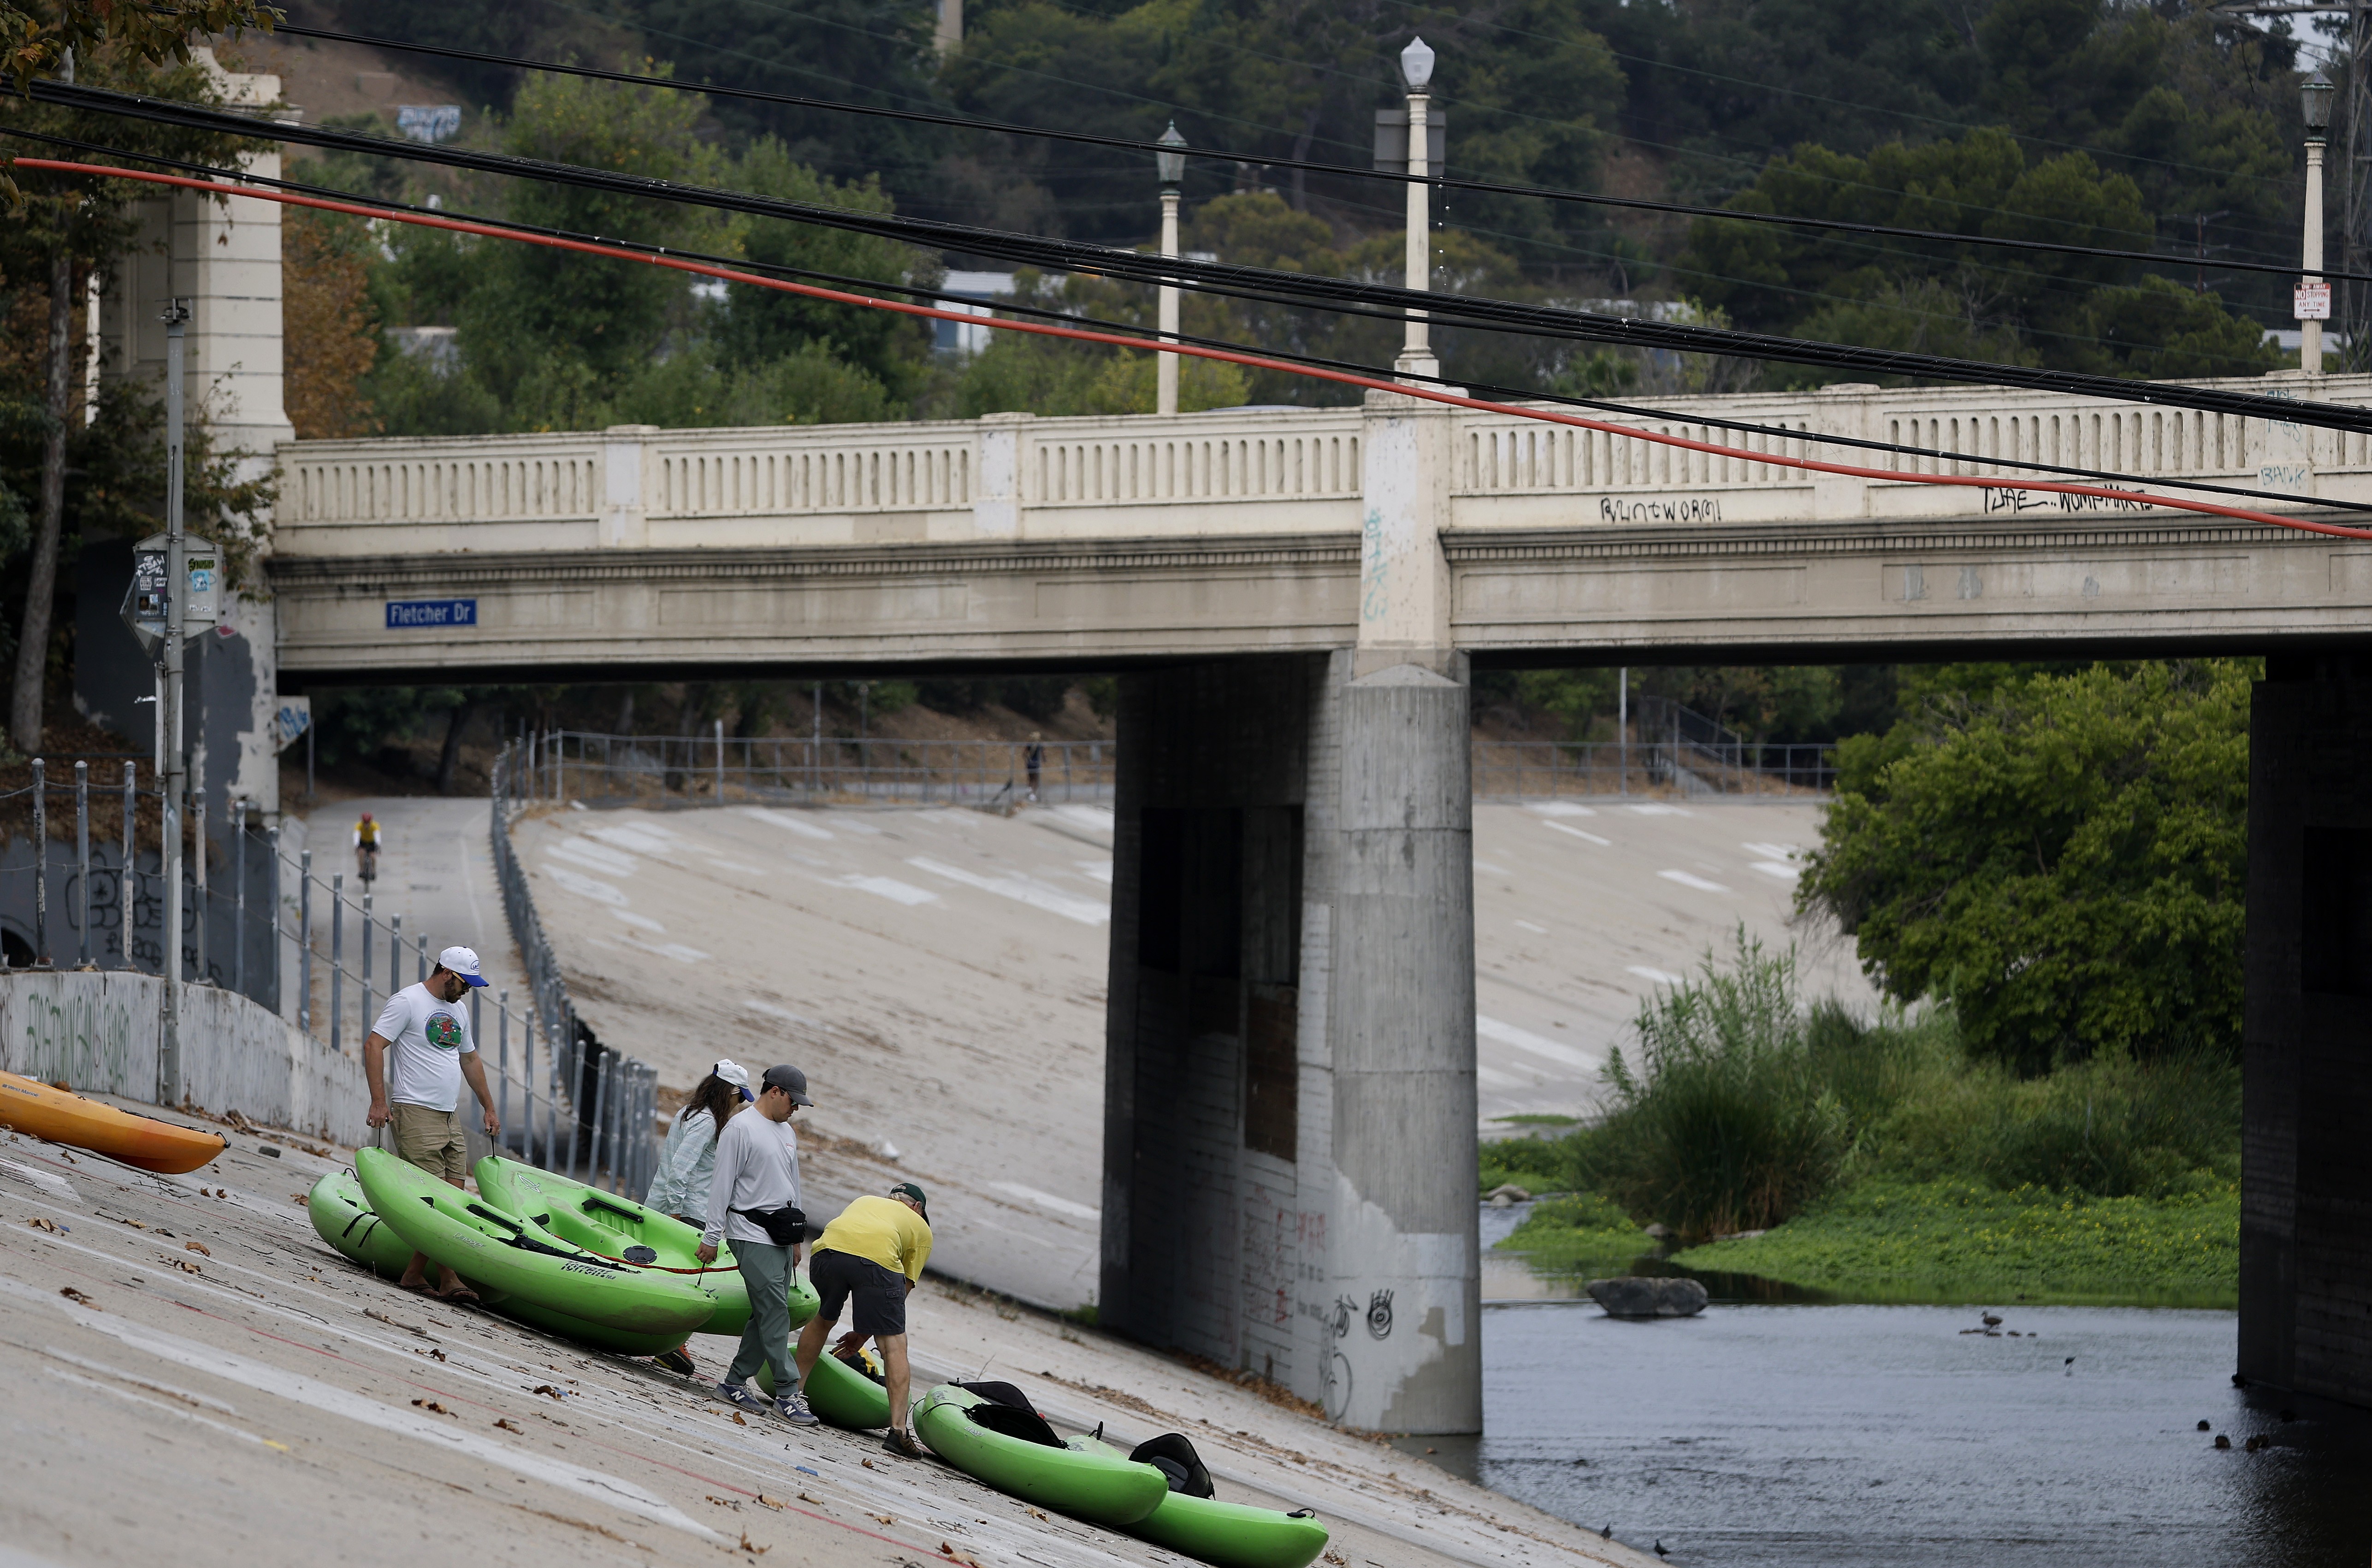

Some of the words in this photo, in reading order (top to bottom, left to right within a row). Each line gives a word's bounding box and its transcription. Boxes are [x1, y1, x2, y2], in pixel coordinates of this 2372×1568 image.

[2295, 290, 2306, 299] NO
[390, 603, 449, 624] Fletcher
[453, 602, 471, 622] Dr
[21, 1089, 39, 1097] Marine
[453, 1232, 486, 1248] Dagger
[561, 1260, 614, 1278] Torrent
[731, 1390, 745, 1401] N
[784, 1404, 797, 1415] N
